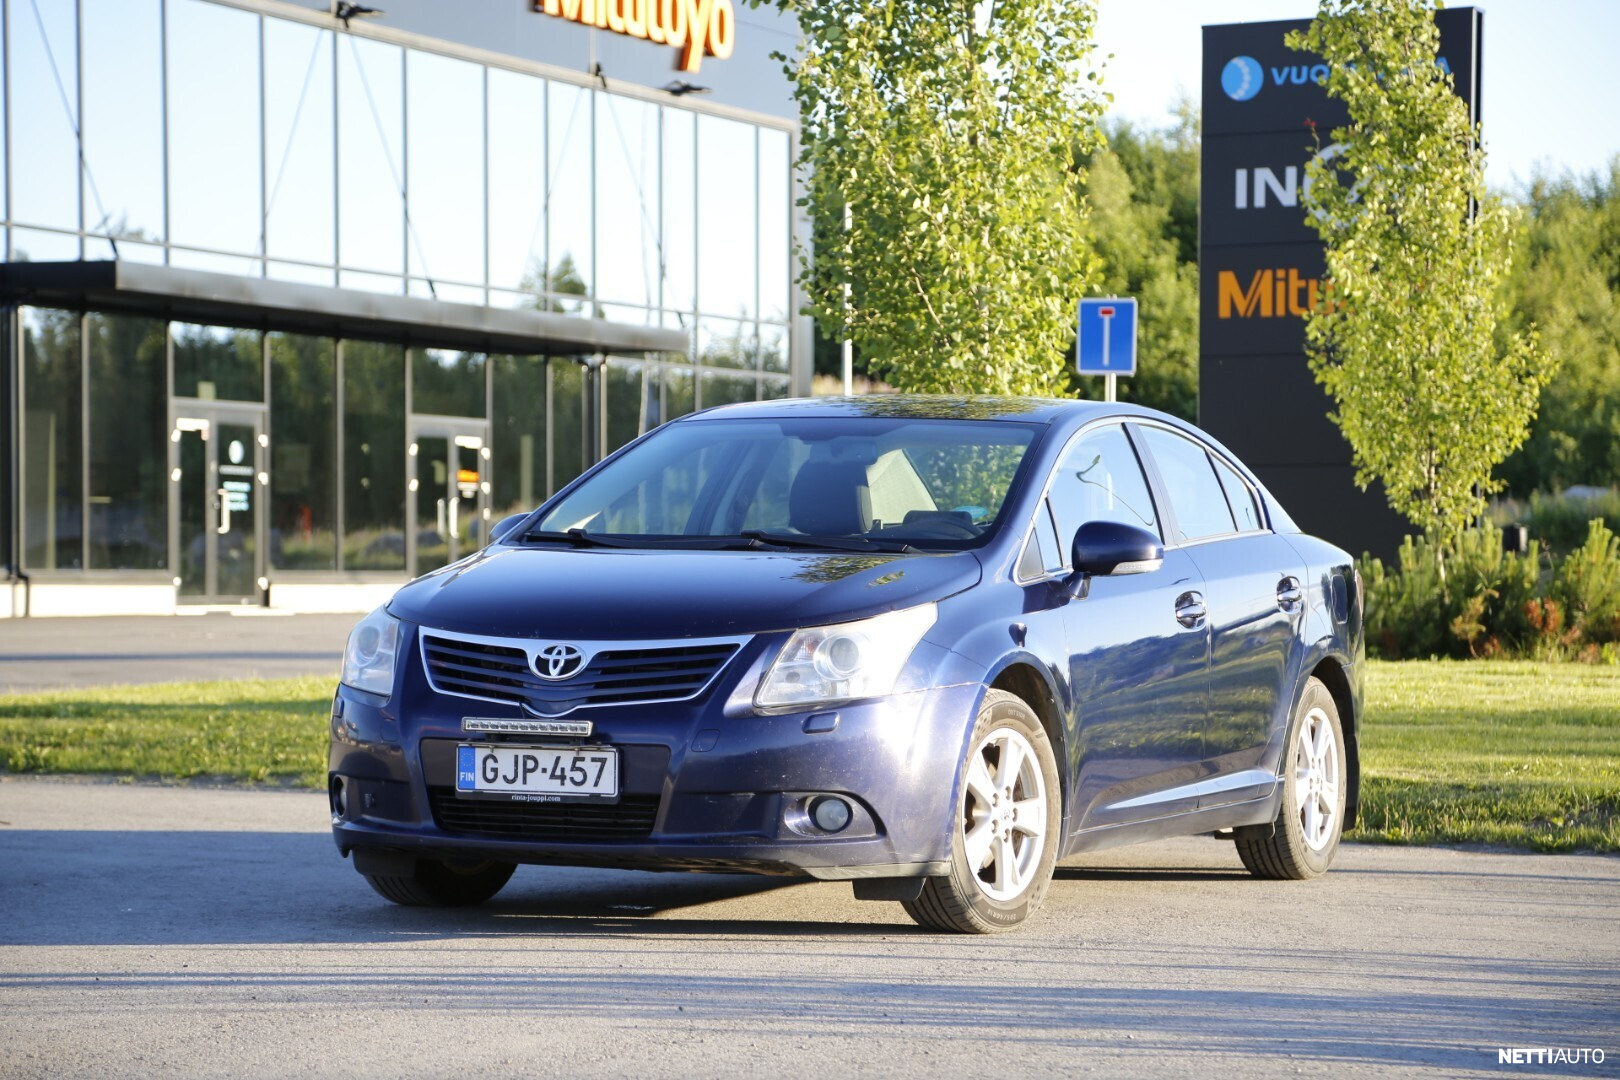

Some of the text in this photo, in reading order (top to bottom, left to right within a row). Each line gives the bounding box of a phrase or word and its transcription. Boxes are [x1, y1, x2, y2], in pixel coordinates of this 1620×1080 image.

[541, 0, 735, 72] utoyo
[1218, 268, 1347, 318] Mitu
[460, 772, 475, 782] FIN
[482, 753, 608, 788] GJP-457
[511, 795, 562, 803] rinta-jouppi.com
